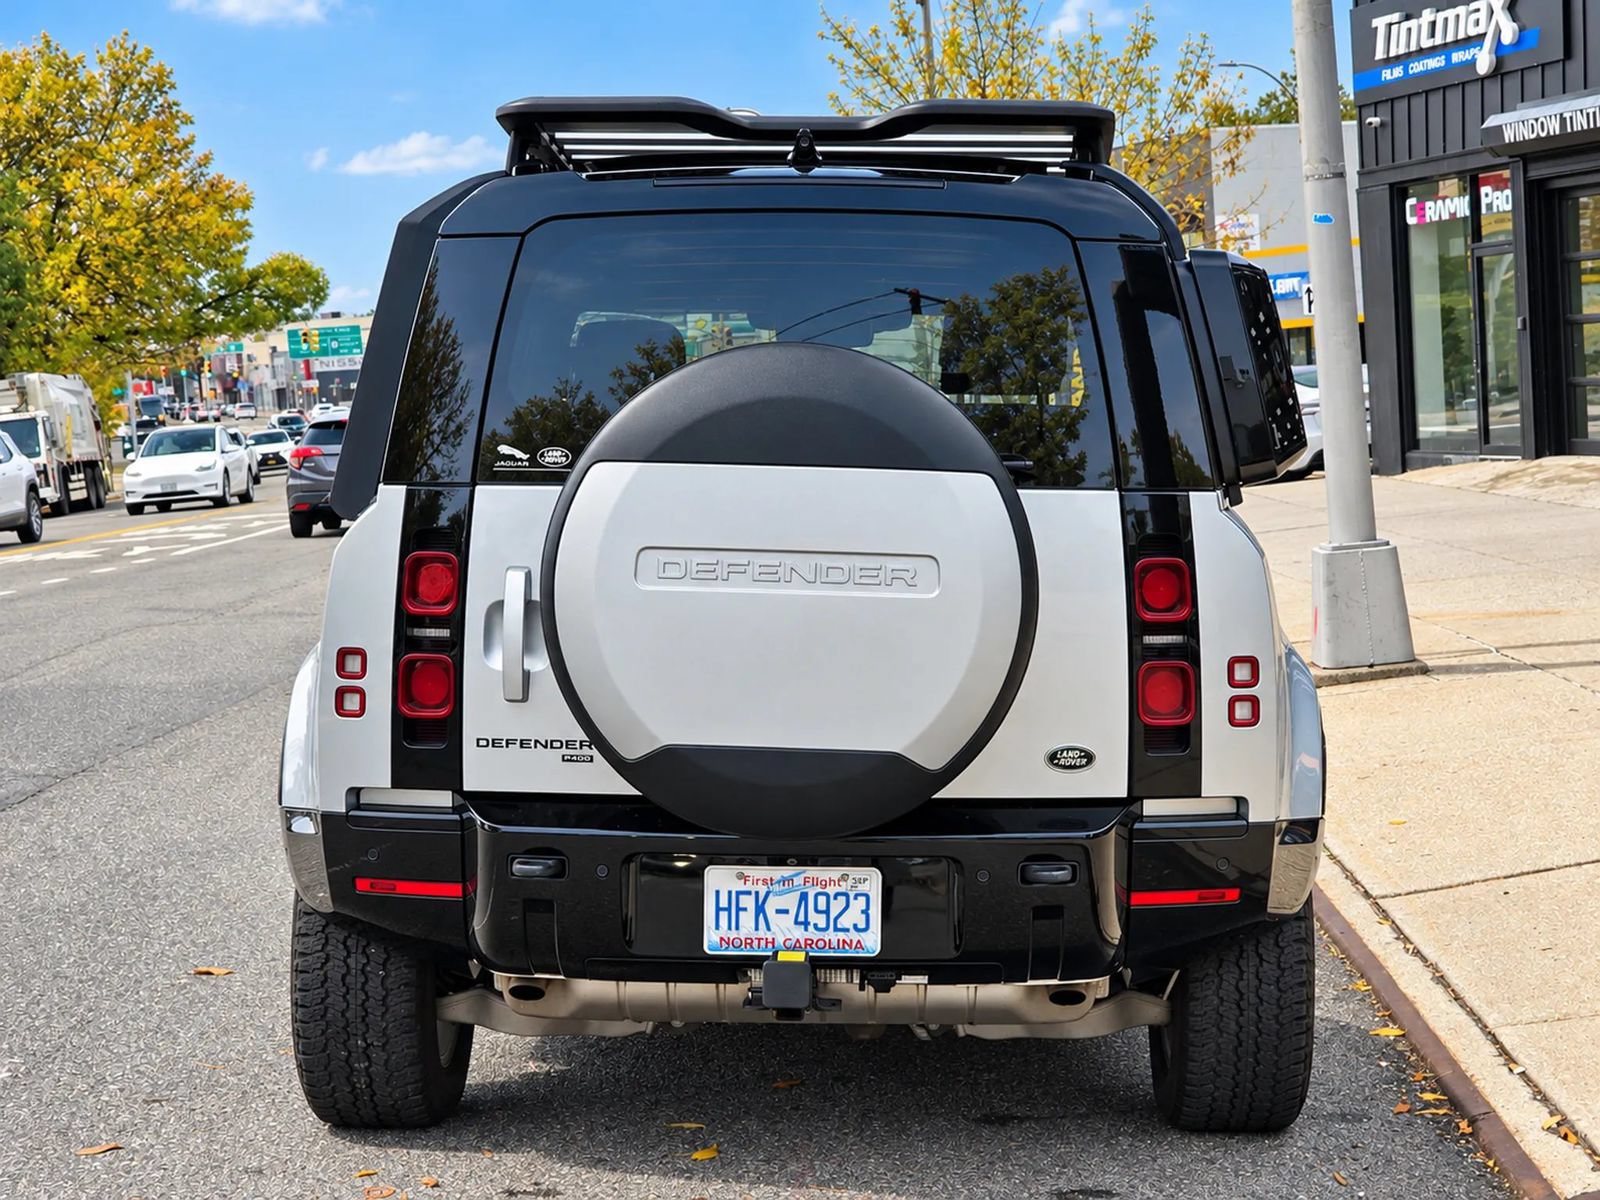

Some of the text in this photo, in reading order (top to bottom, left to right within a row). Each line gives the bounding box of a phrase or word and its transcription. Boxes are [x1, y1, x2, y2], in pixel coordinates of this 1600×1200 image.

[1408, 55, 1446, 75] COATINGS
[1451, 46, 1481, 64] WRAPS
[1502, 106, 1600, 144] WINDOW TINTI
[656, 555, 918, 587] DEFENDER
[476, 737, 593, 750] DEFENDER
[743, 875, 775, 886] First
[803, 876, 842, 889] Flight
[714, 889, 871, 933] HFK-4923
[719, 936, 865, 950] NORTH CAROLINA
